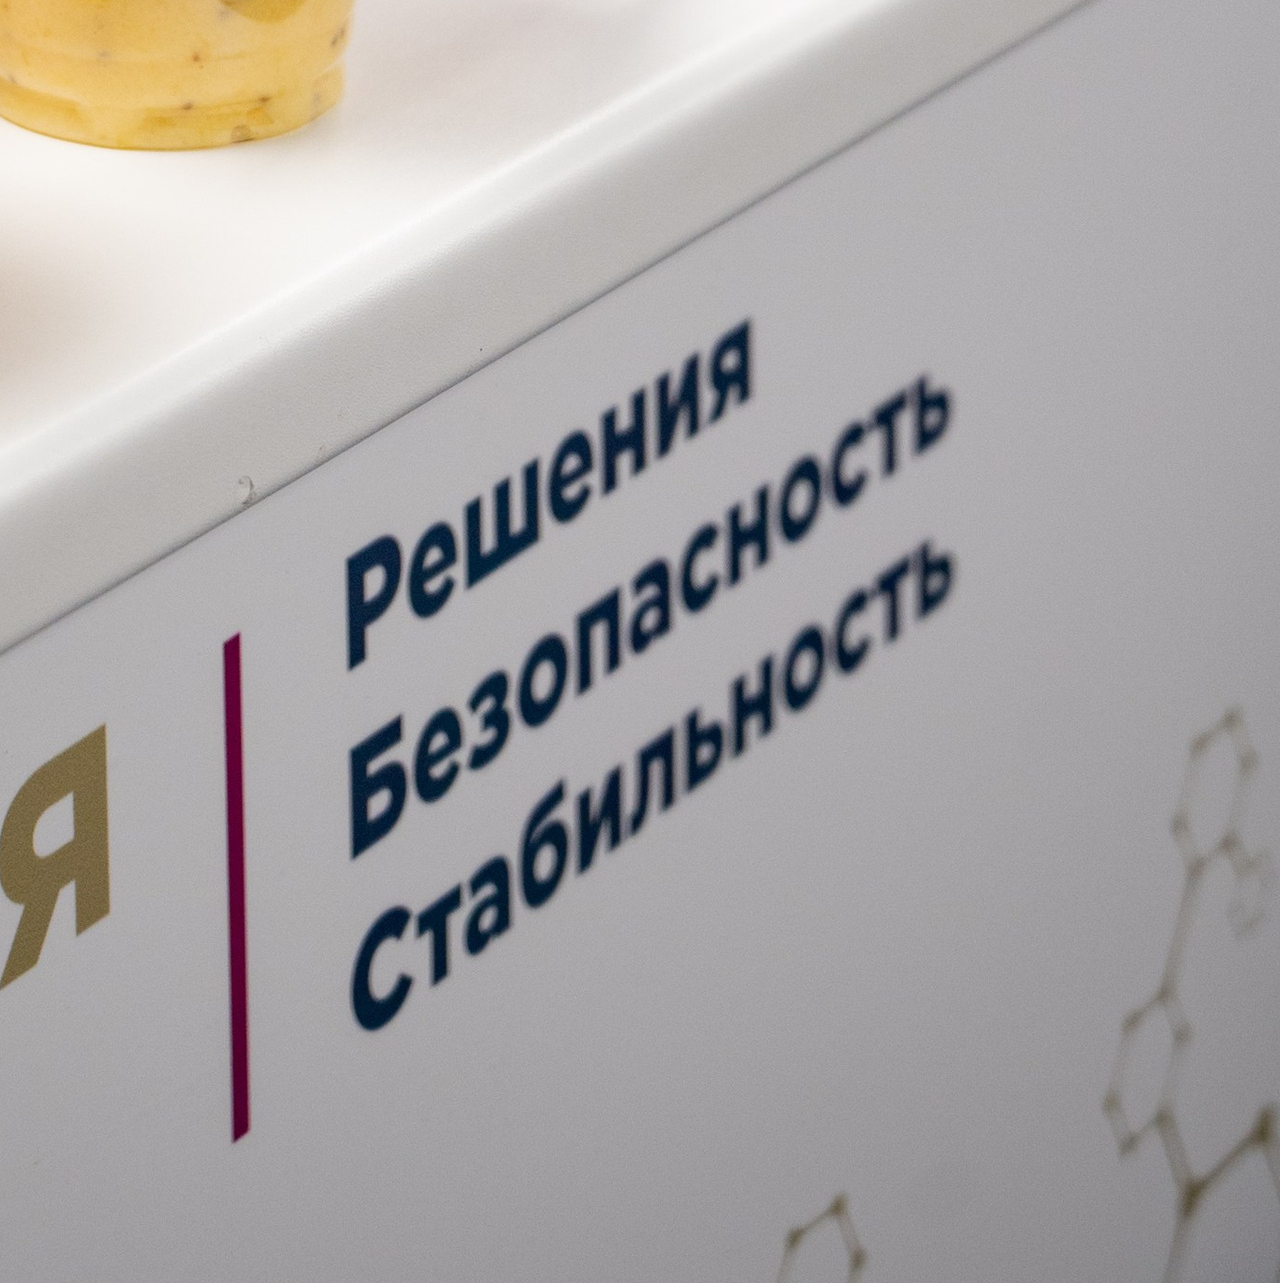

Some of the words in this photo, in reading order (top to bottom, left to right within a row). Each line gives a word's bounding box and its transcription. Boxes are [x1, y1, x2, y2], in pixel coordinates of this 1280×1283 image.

[346, 317, 754, 671] Решения
[349, 372, 954, 861] Безопасность
[350, 537, 958, 1032] Стабильность
